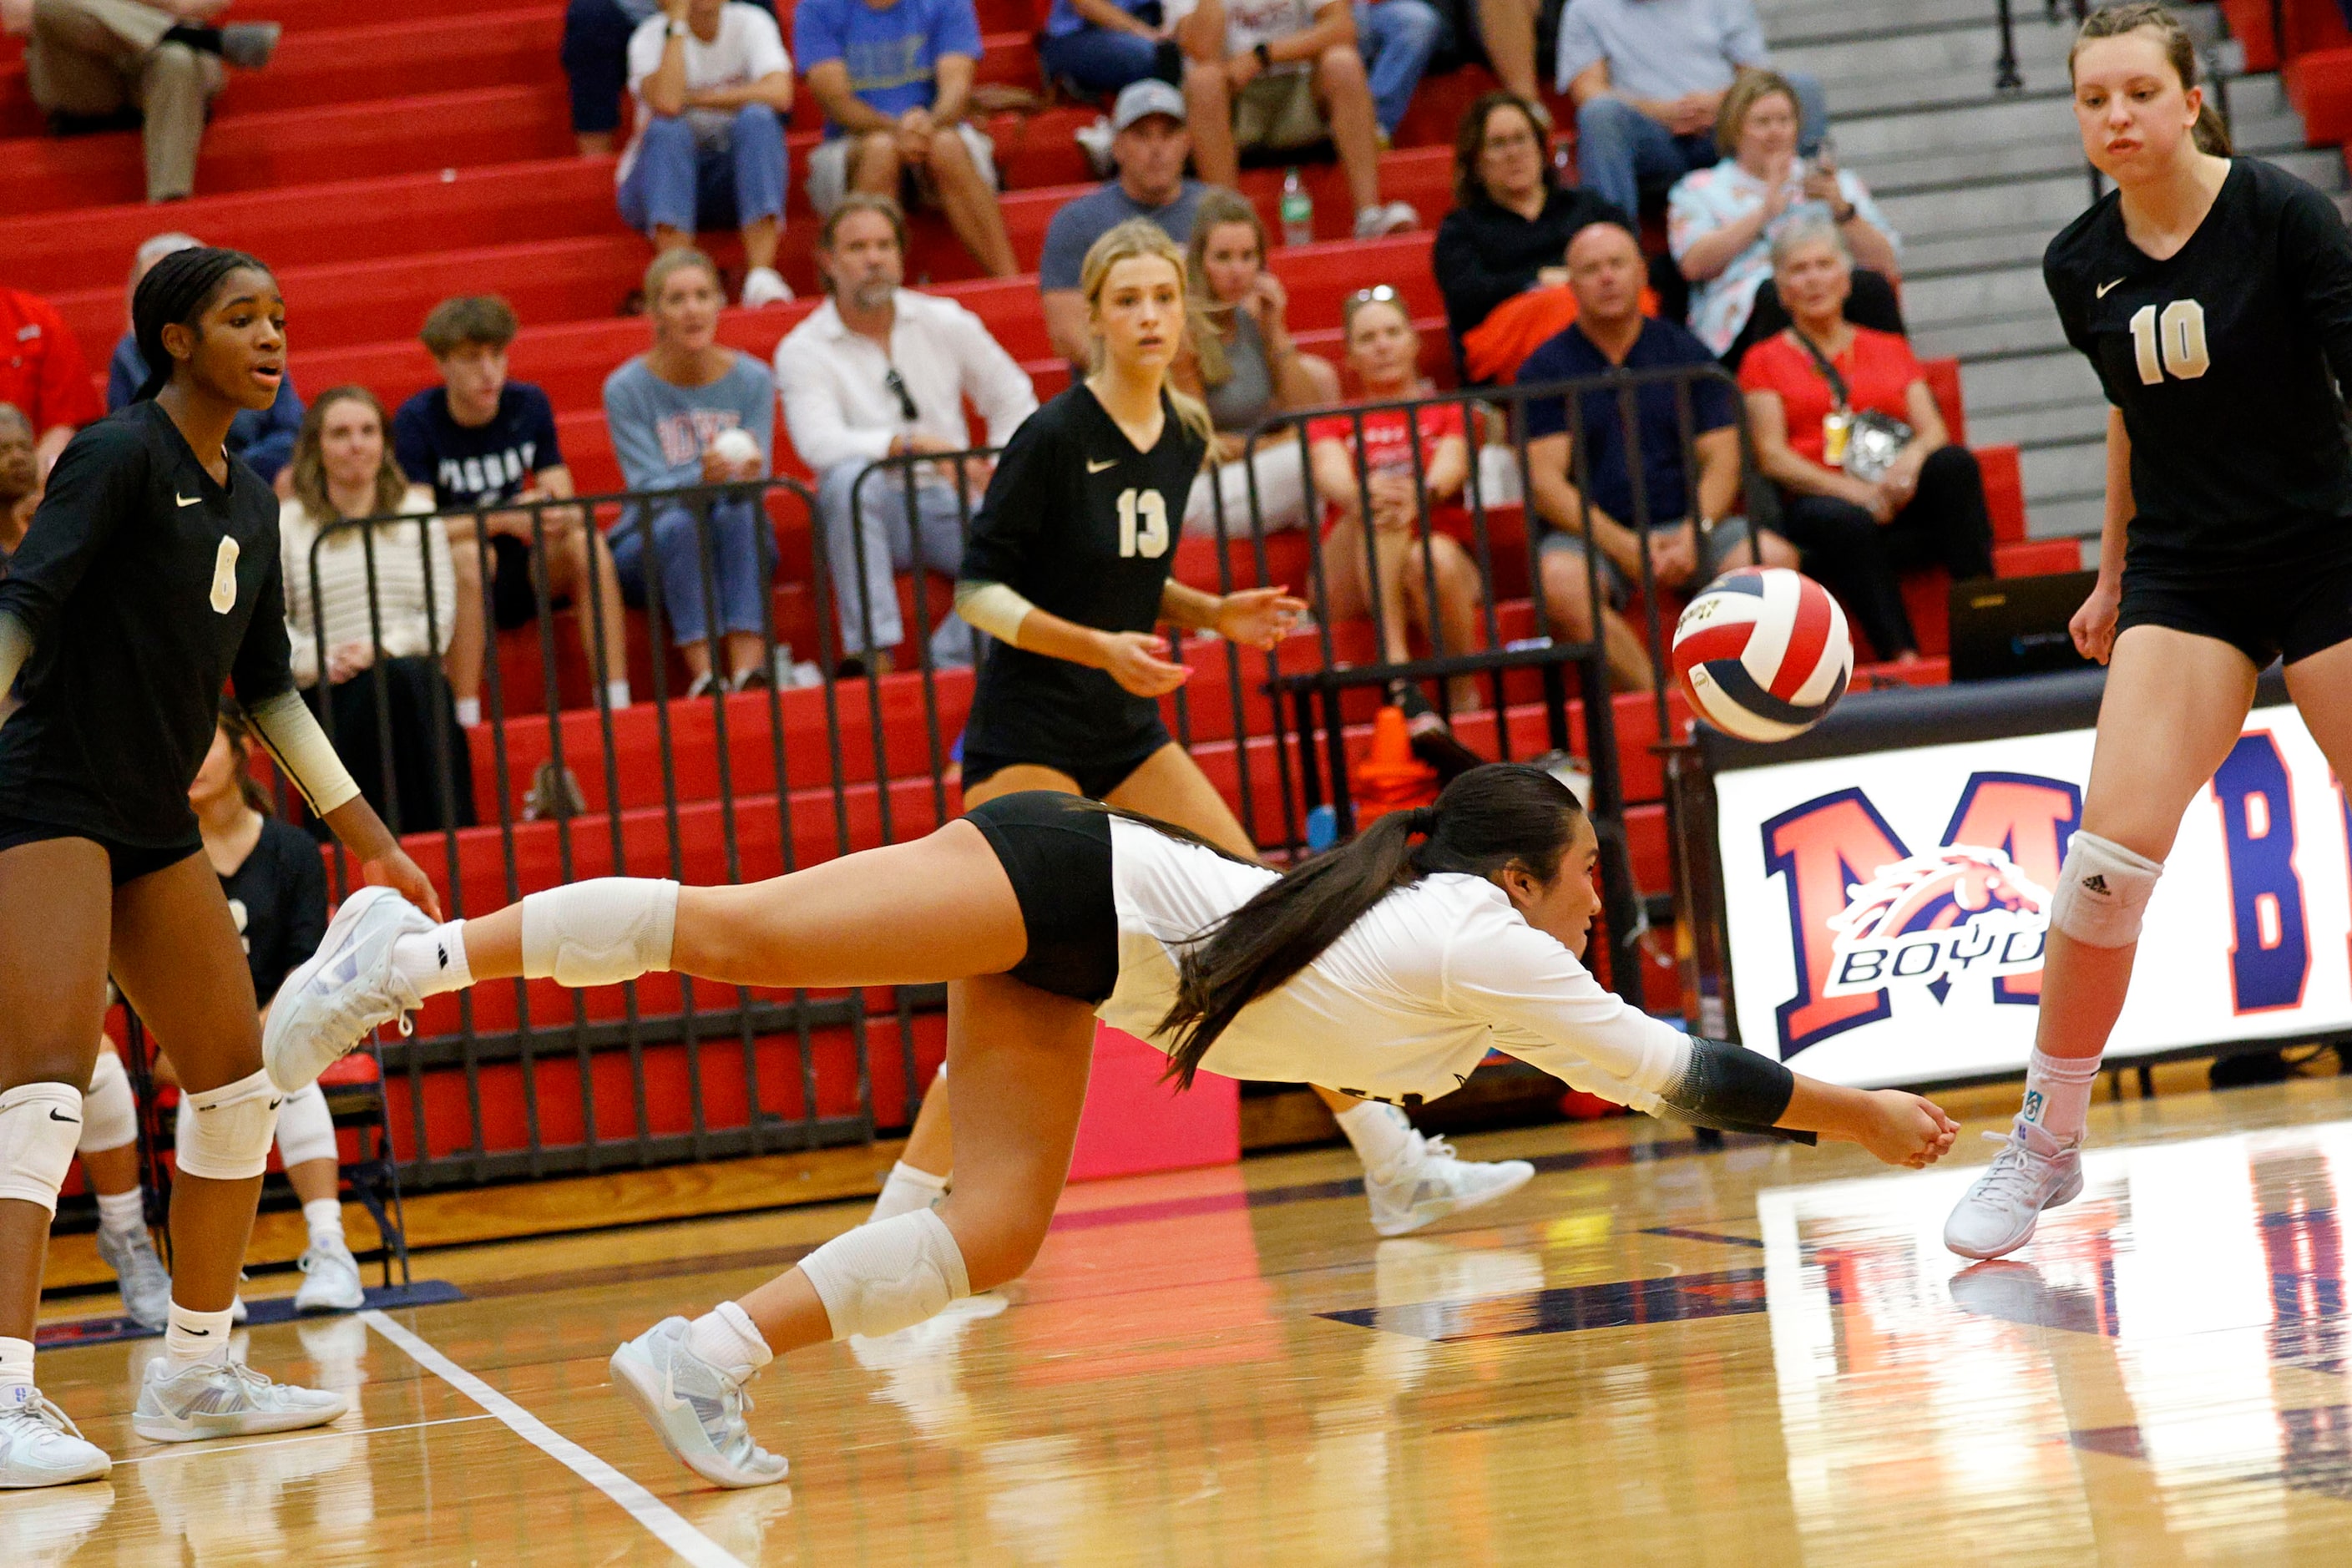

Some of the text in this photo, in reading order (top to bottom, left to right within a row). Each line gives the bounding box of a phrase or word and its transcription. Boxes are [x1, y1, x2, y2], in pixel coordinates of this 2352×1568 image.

[2129, 298, 2211, 385] 10
[1116, 487, 1169, 558] 13
[2209, 727, 2352, 1016] B
[1839, 923, 2046, 985] BOYD
